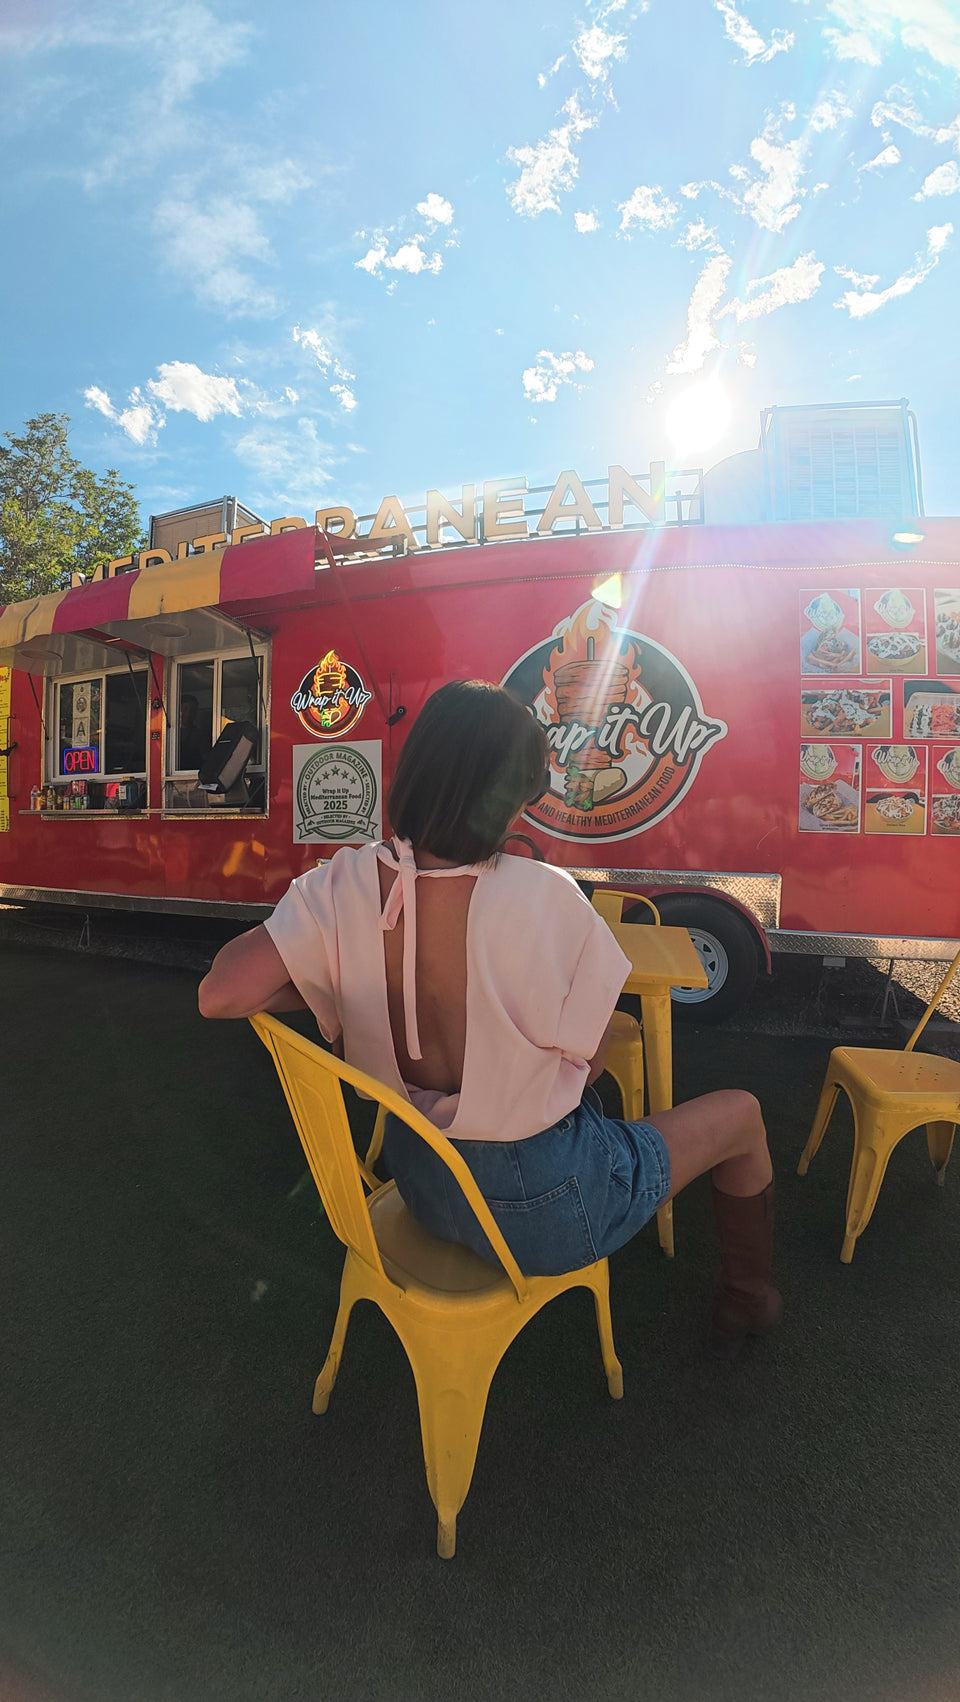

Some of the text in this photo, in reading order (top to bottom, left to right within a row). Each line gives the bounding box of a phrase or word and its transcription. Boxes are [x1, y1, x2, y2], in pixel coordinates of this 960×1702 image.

[293, 687, 370, 711] Wrap it Up
[598, 706, 639, 756] it
[640, 702, 717, 763] Up
[65, 750, 95, 772] OPEN
[305, 752, 369, 780] OUTDOOR MAGAZINE
[323, 800, 348, 810] 2025
[537, 766, 676, 828] AND HEALTHY MEDITERRANEAN FOOD
